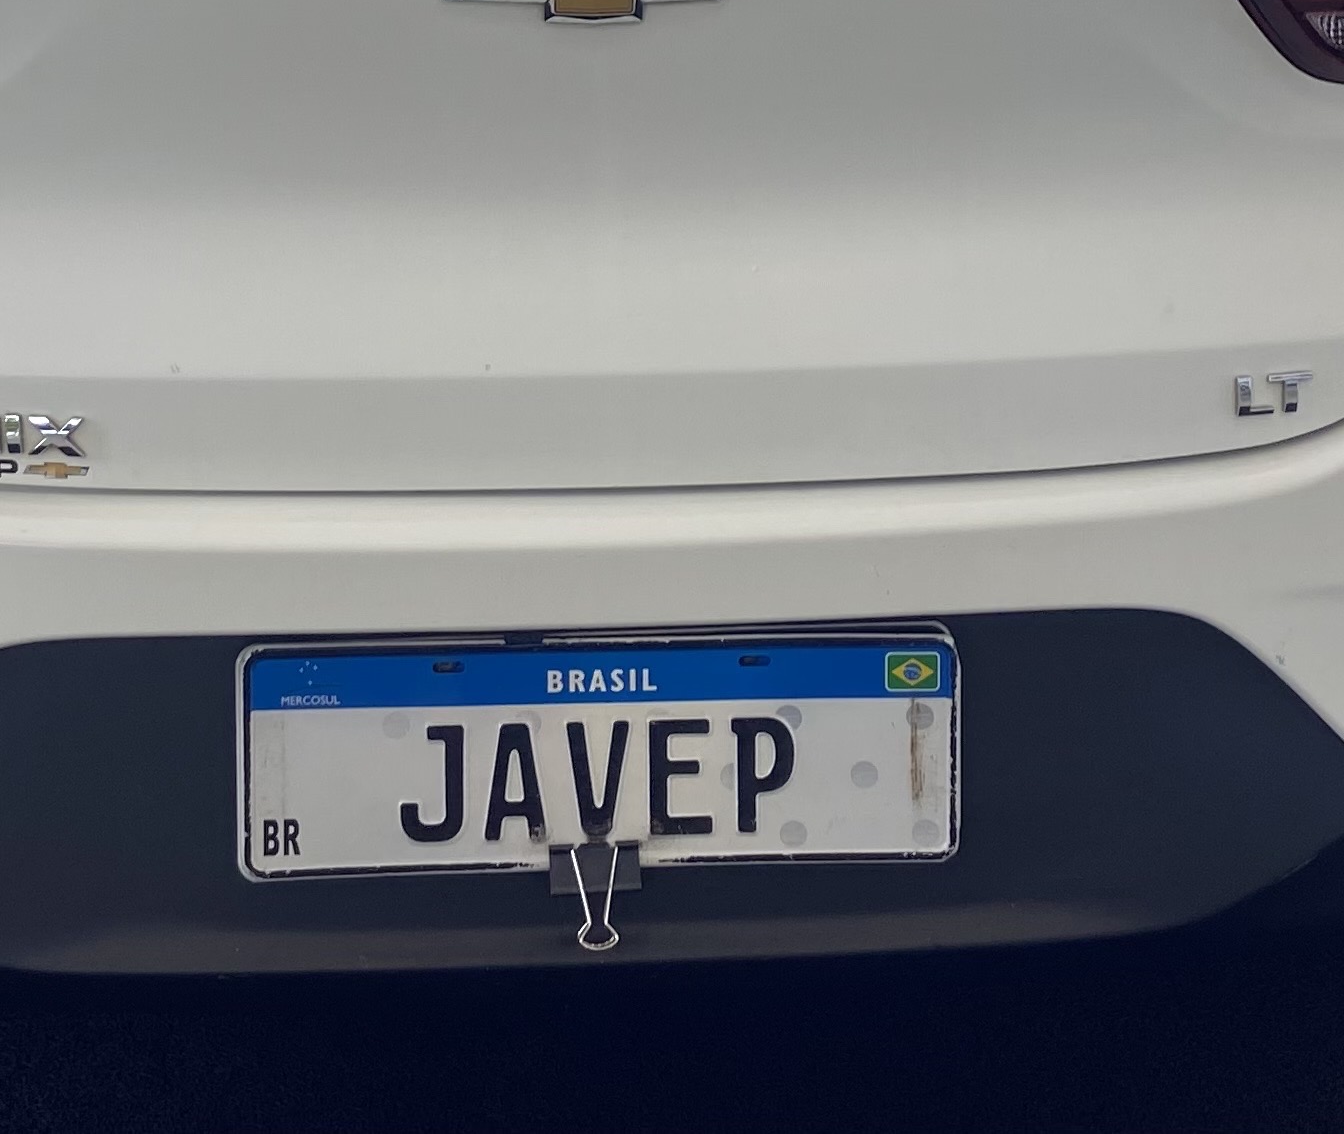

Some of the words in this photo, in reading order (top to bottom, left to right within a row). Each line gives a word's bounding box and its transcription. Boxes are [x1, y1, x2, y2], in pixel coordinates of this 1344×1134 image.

[1235, 370, 1313, 416] LT
[547, 668, 657, 693] BRASIL
[280, 694, 341, 706] MERCOSUL
[400, 717, 795, 843] JAVEP
[263, 818, 301, 856] BR
